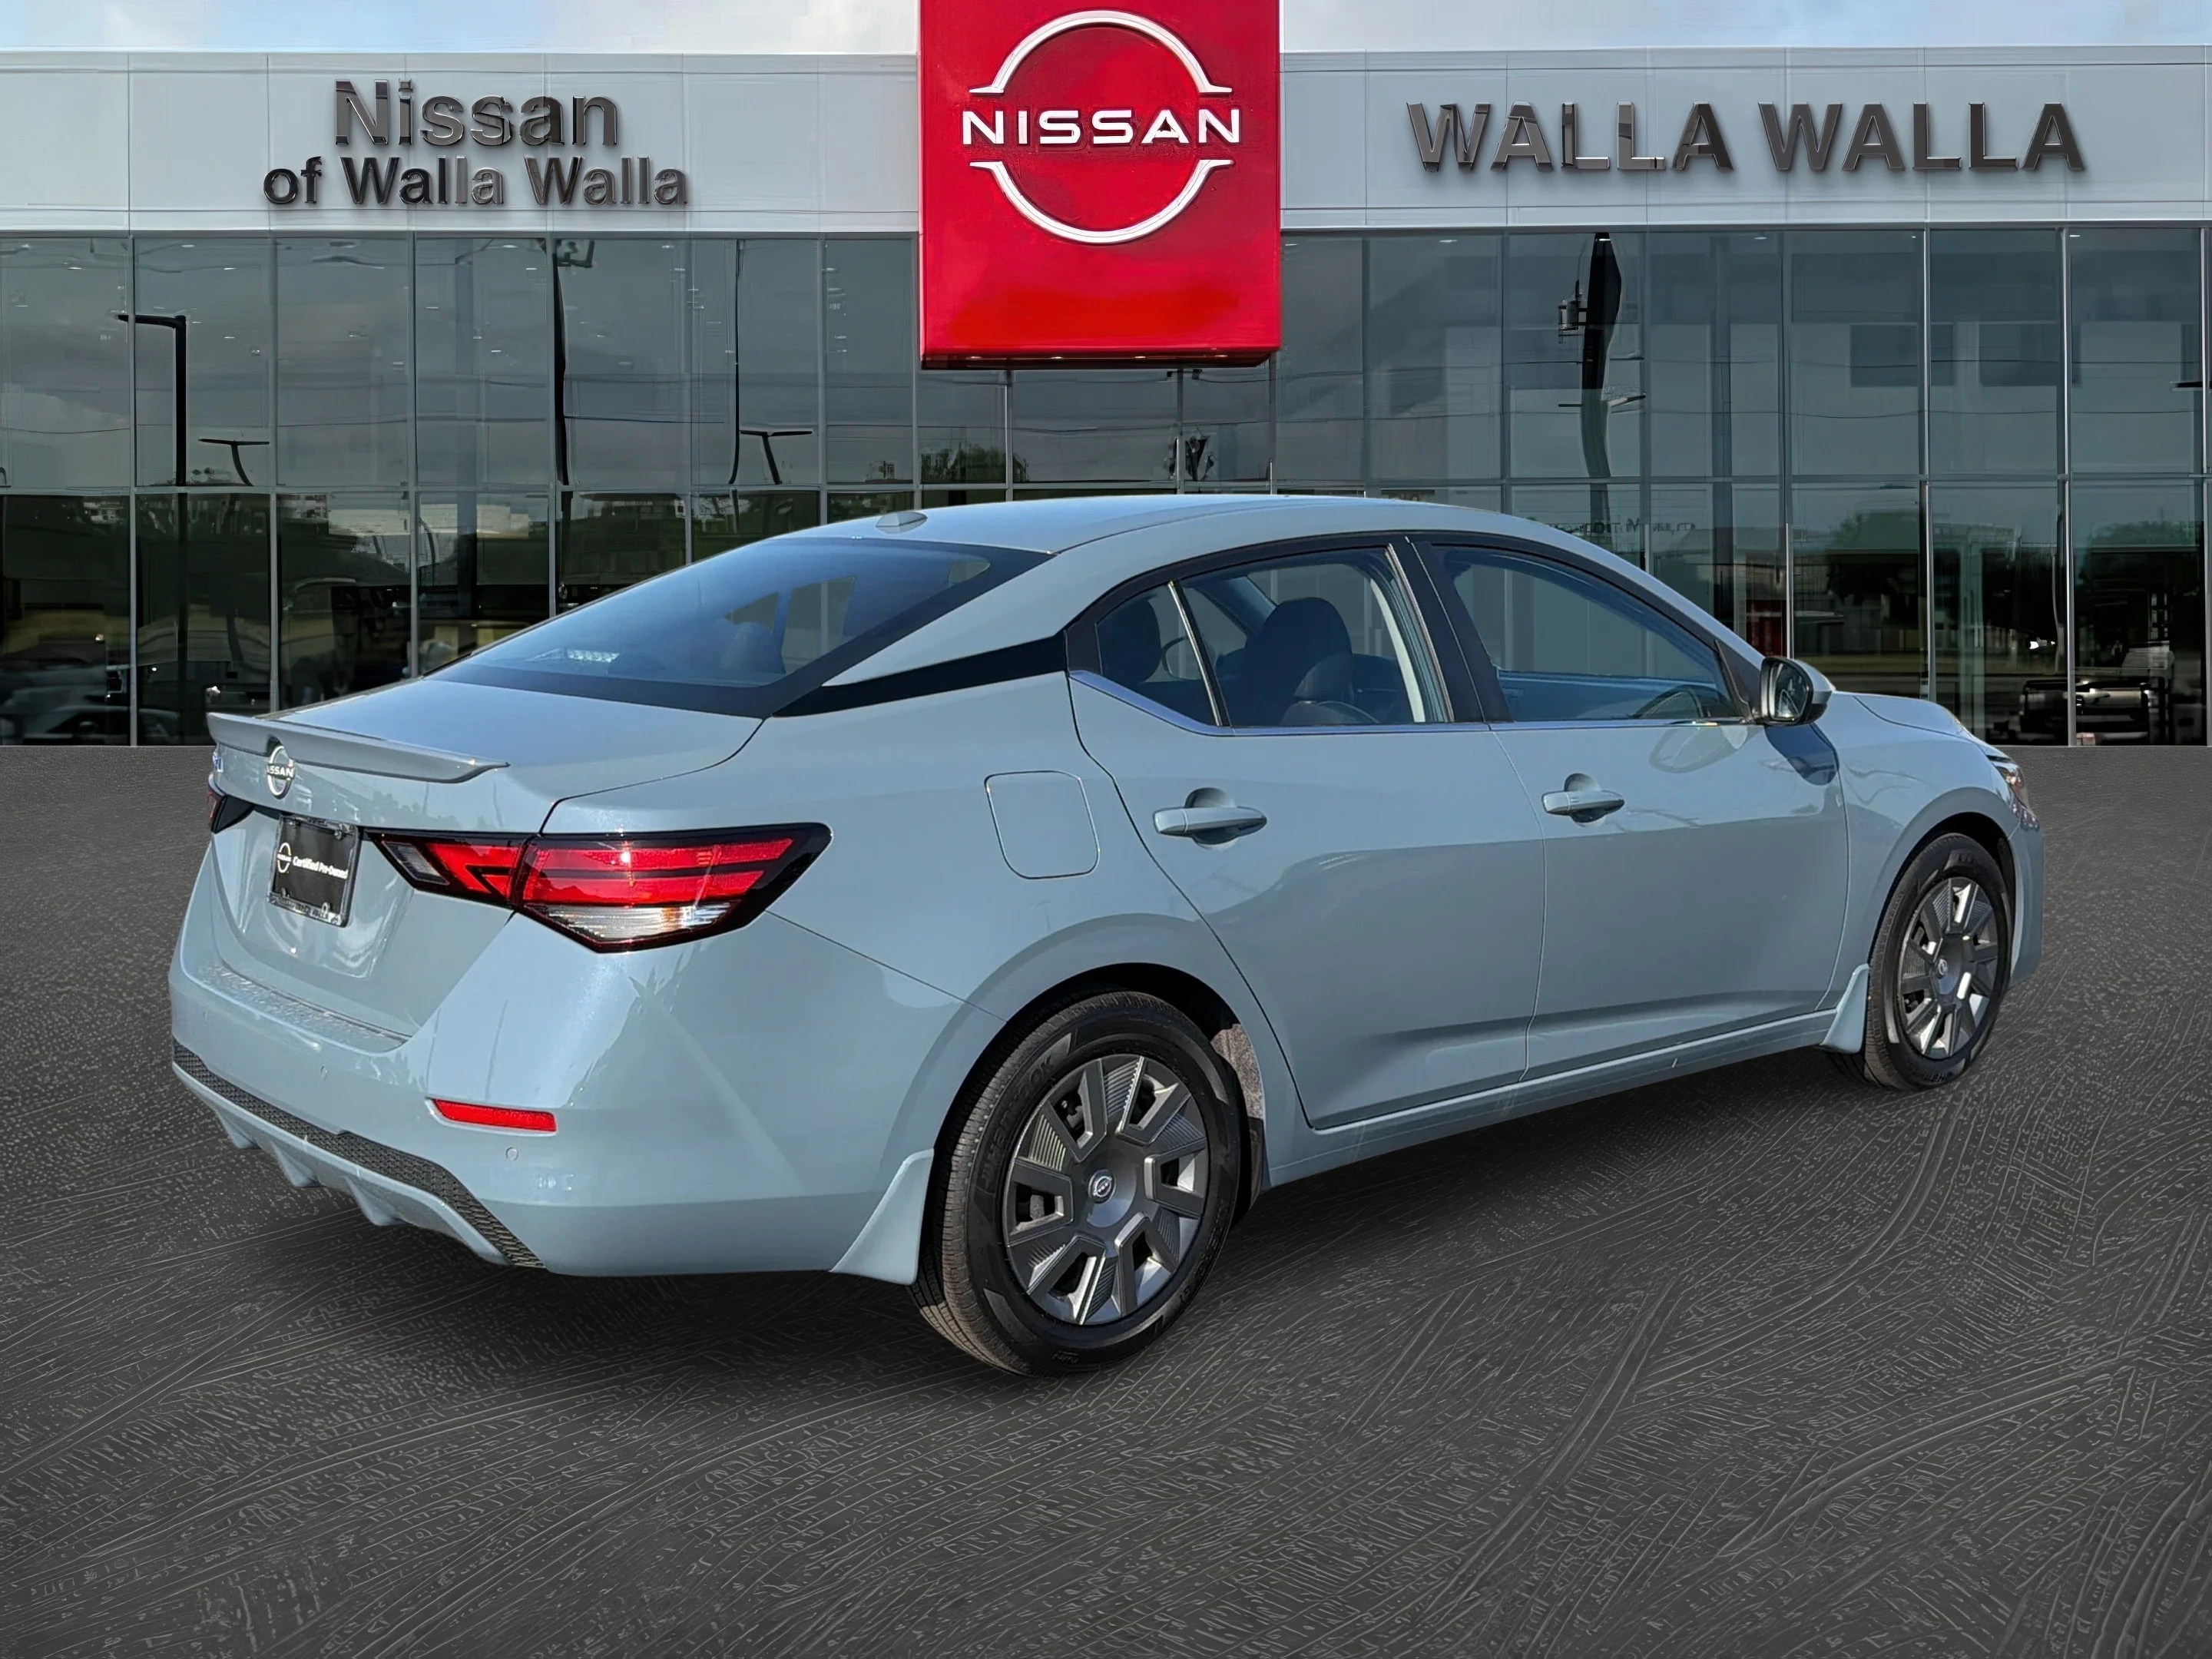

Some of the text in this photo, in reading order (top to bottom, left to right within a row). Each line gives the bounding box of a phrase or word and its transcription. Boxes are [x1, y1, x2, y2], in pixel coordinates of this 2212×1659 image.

[335, 78, 618, 145] Nissan
[962, 108, 1240, 146] NISSAN
[1406, 101, 2085, 173] WALLA WALLA
[263, 156, 687, 205] of Walla Walla
